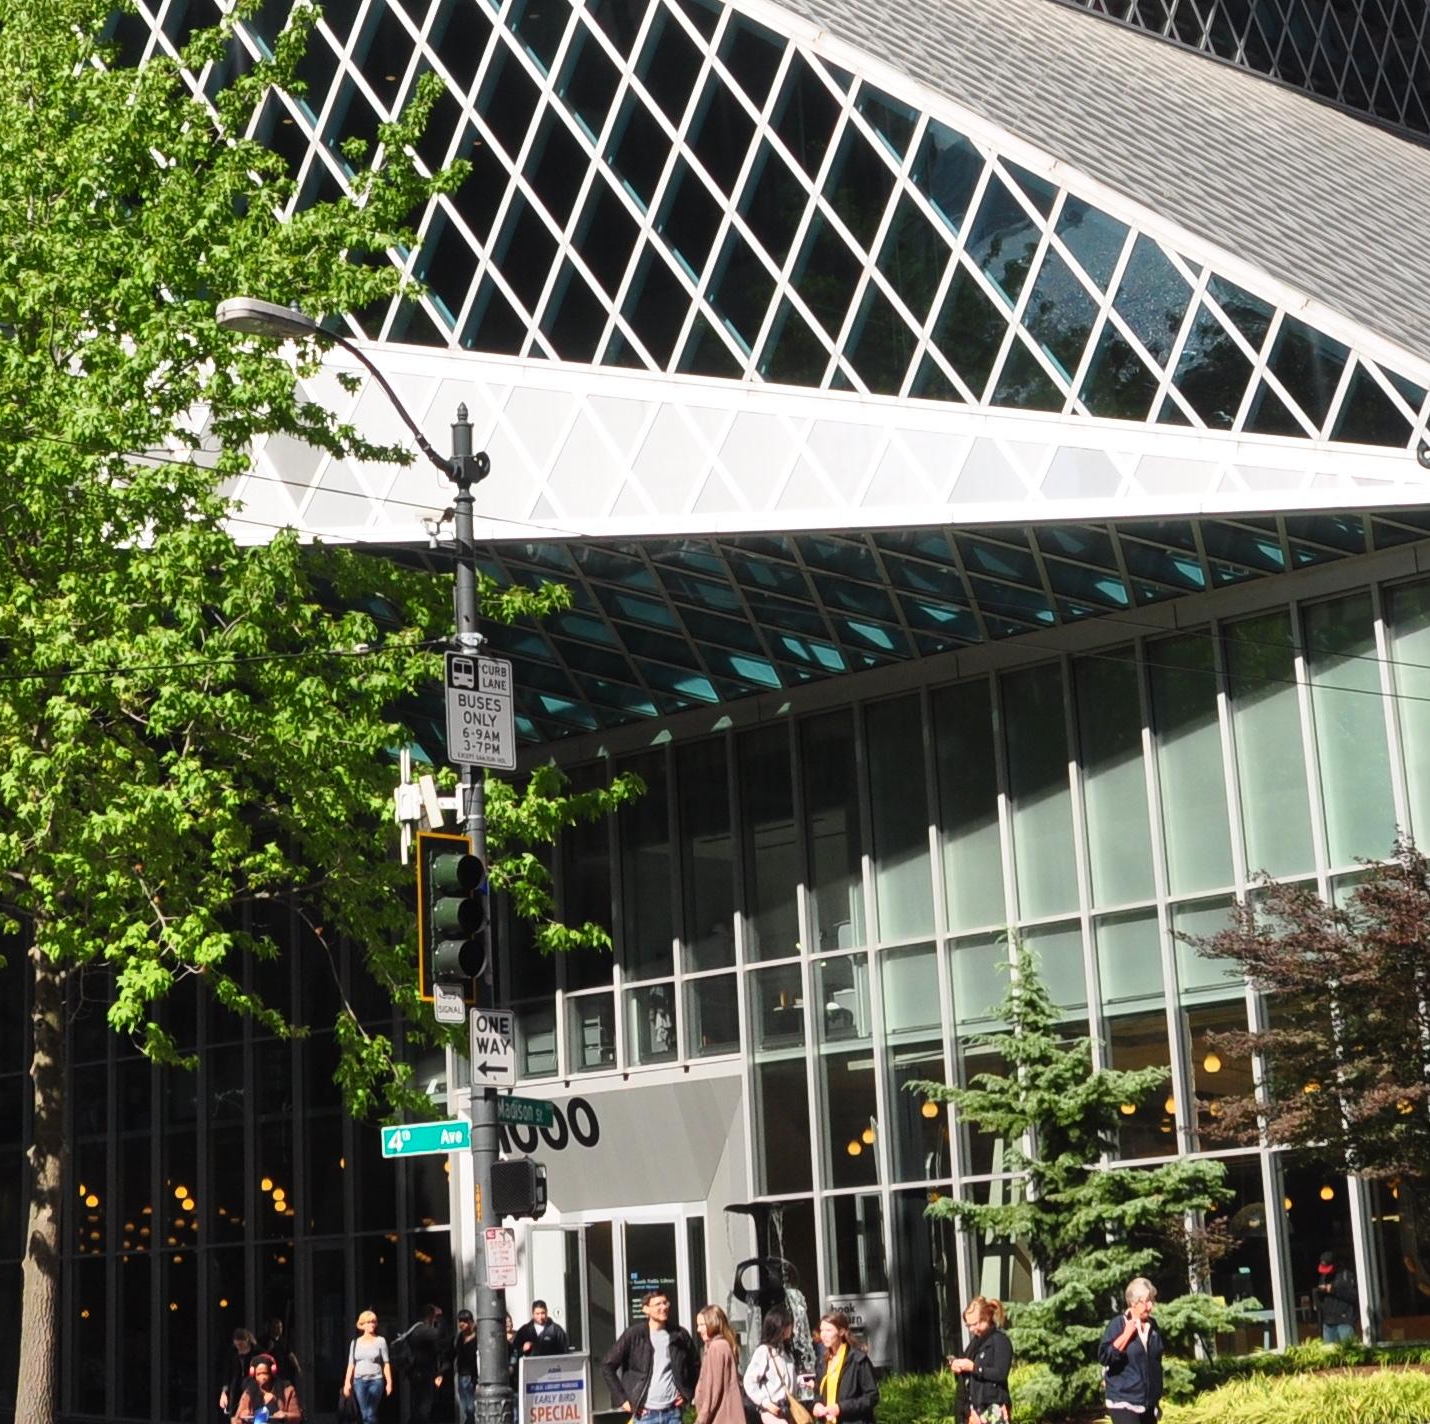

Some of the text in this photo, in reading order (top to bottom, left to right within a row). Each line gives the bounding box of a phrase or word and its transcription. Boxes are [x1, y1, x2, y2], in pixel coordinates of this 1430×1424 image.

[482, 663, 507, 677] CURB
[482, 678, 507, 691] LANE
[458, 694, 502, 712] BUSES
[463, 711, 497, 727] ONLY
[462, 728, 501, 742] 6-9AM
[463, 740, 501, 755] 3-7PM
[438, 1005, 463, 1015] SIGNAL
[476, 1016, 509, 1034] ONE
[476, 1037, 511, 1055] WAY
[497, 1096, 534, 1122] Madison
[388, 1128, 463, 1152] 4th Ave
[534, 1393, 576, 1405] EARLY BIRD
[530, 1404, 581, 1423] SPECIAL
